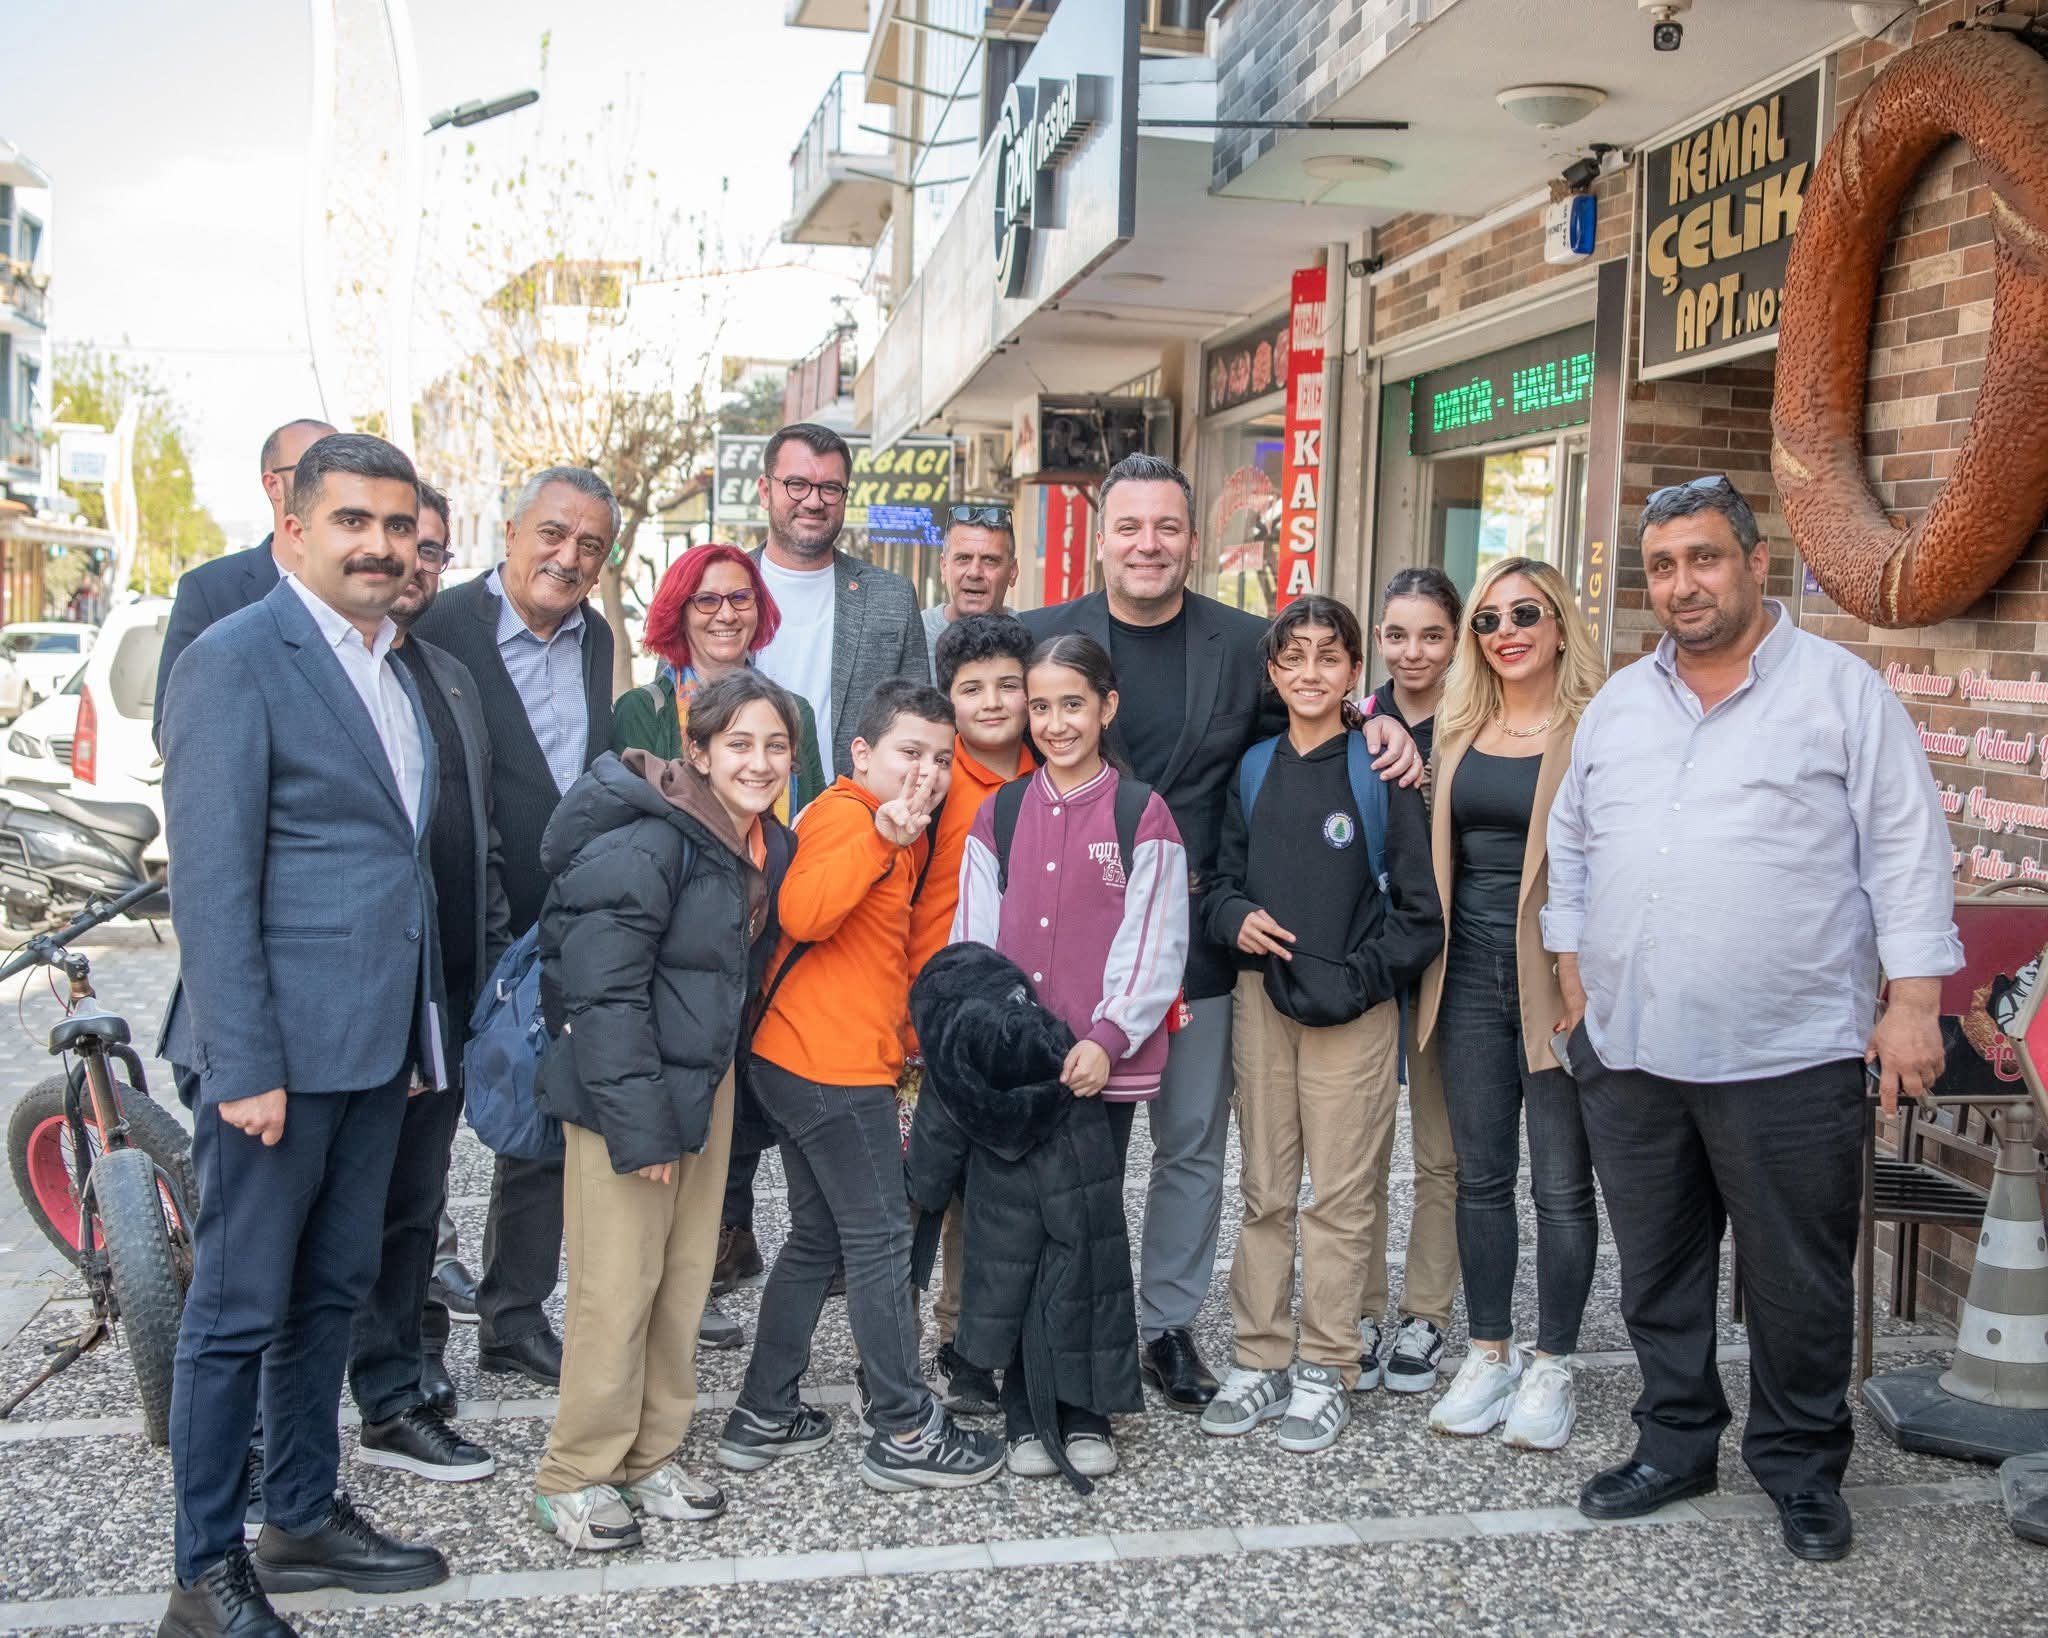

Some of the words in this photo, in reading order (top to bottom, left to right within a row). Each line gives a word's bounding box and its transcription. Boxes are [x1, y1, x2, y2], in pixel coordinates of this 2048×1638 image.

[1036, 74, 1078, 172] DESIGN
[1669, 95, 1785, 206] KEMAL
[1647, 161, 1809, 297] ÇELİK
[1512, 352, 1595, 415] HAVLUP
[720, 443, 765, 470] EF
[849, 446, 951, 475] RBACI
